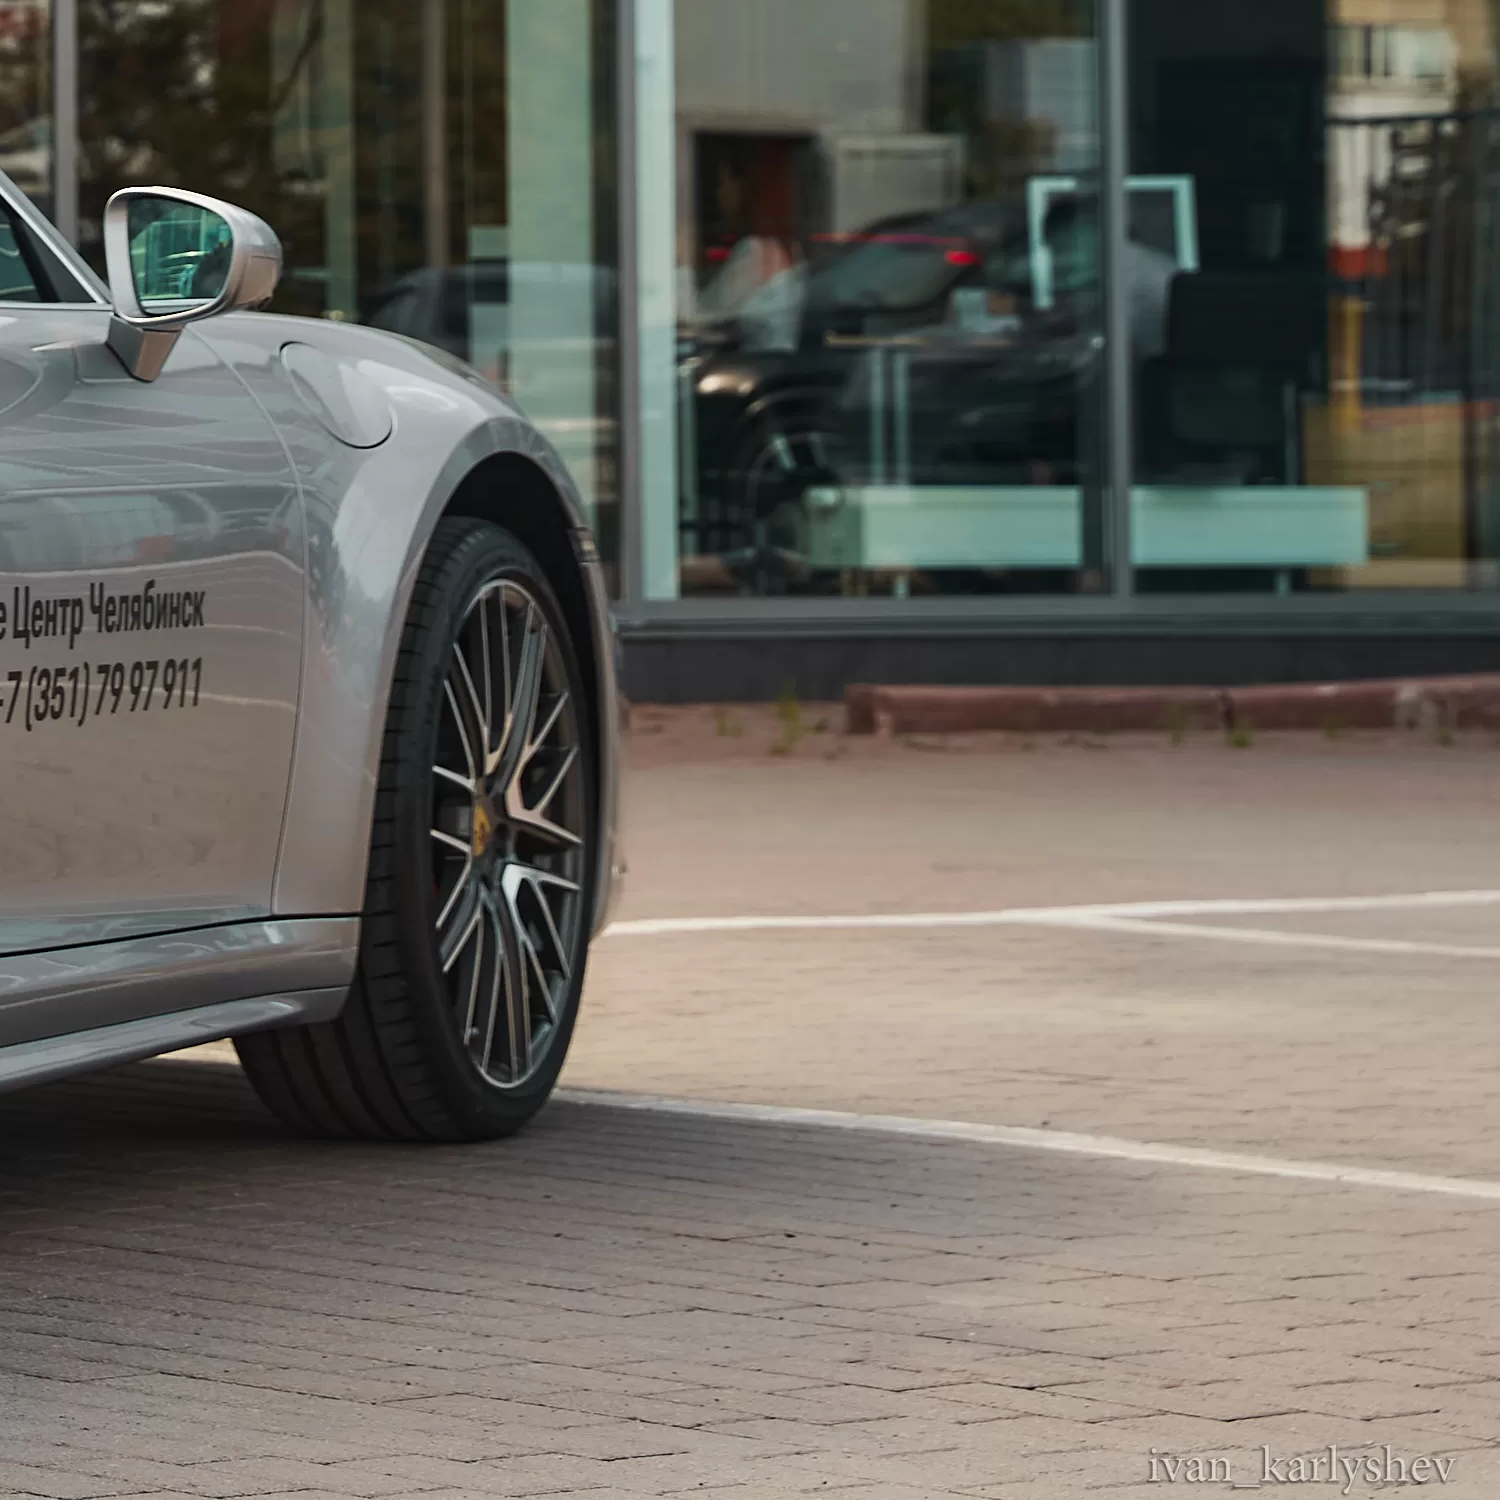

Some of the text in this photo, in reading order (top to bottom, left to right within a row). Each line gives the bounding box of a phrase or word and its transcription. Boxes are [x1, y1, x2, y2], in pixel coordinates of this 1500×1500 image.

[12, 586, 83, 650] Центр
[90, 579, 206, 633] Челябинск
[25, 662, 90, 731] (351)
[163, 657, 202, 709] 911
